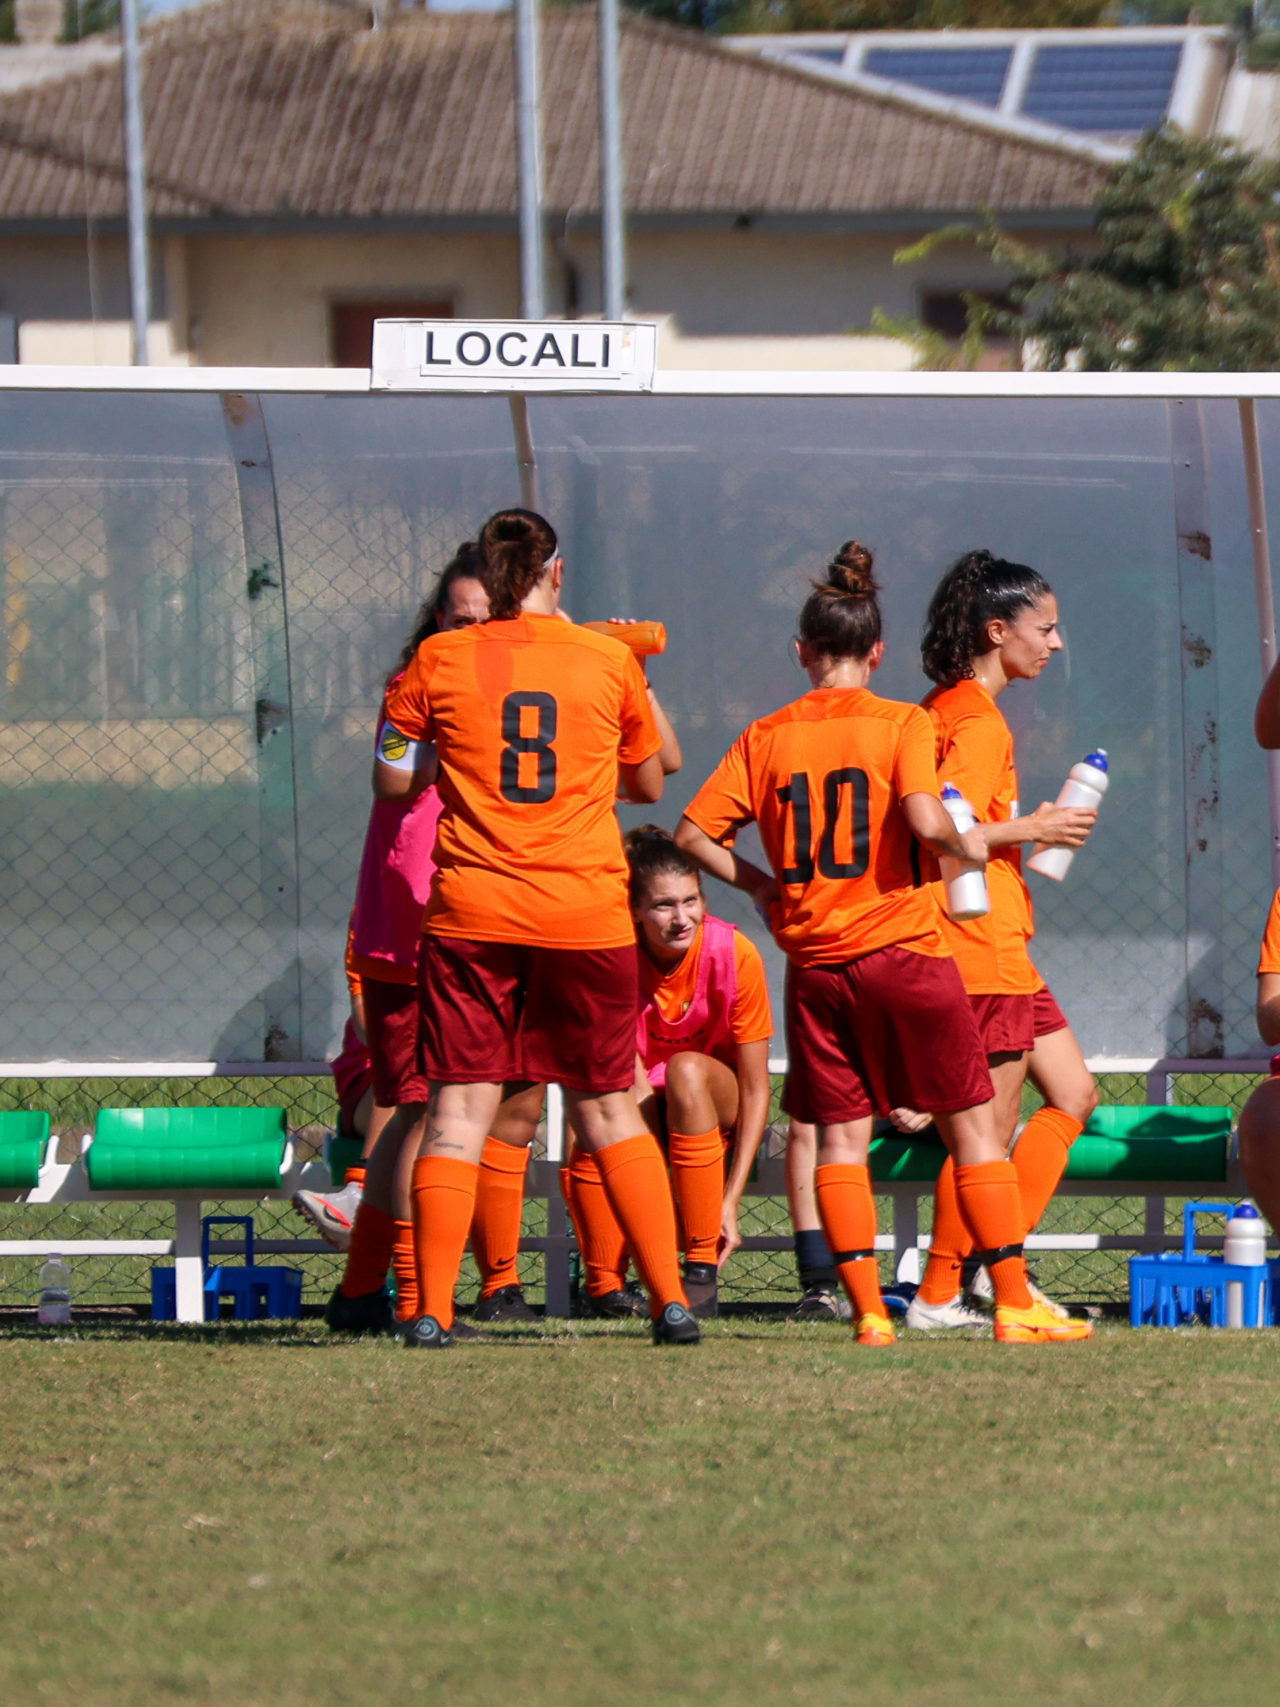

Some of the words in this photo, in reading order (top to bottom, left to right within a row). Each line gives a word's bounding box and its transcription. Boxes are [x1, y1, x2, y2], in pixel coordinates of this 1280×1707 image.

[425, 330, 610, 368] LOCALI
[500, 691, 557, 804] 8
[775, 767, 870, 885] 10
